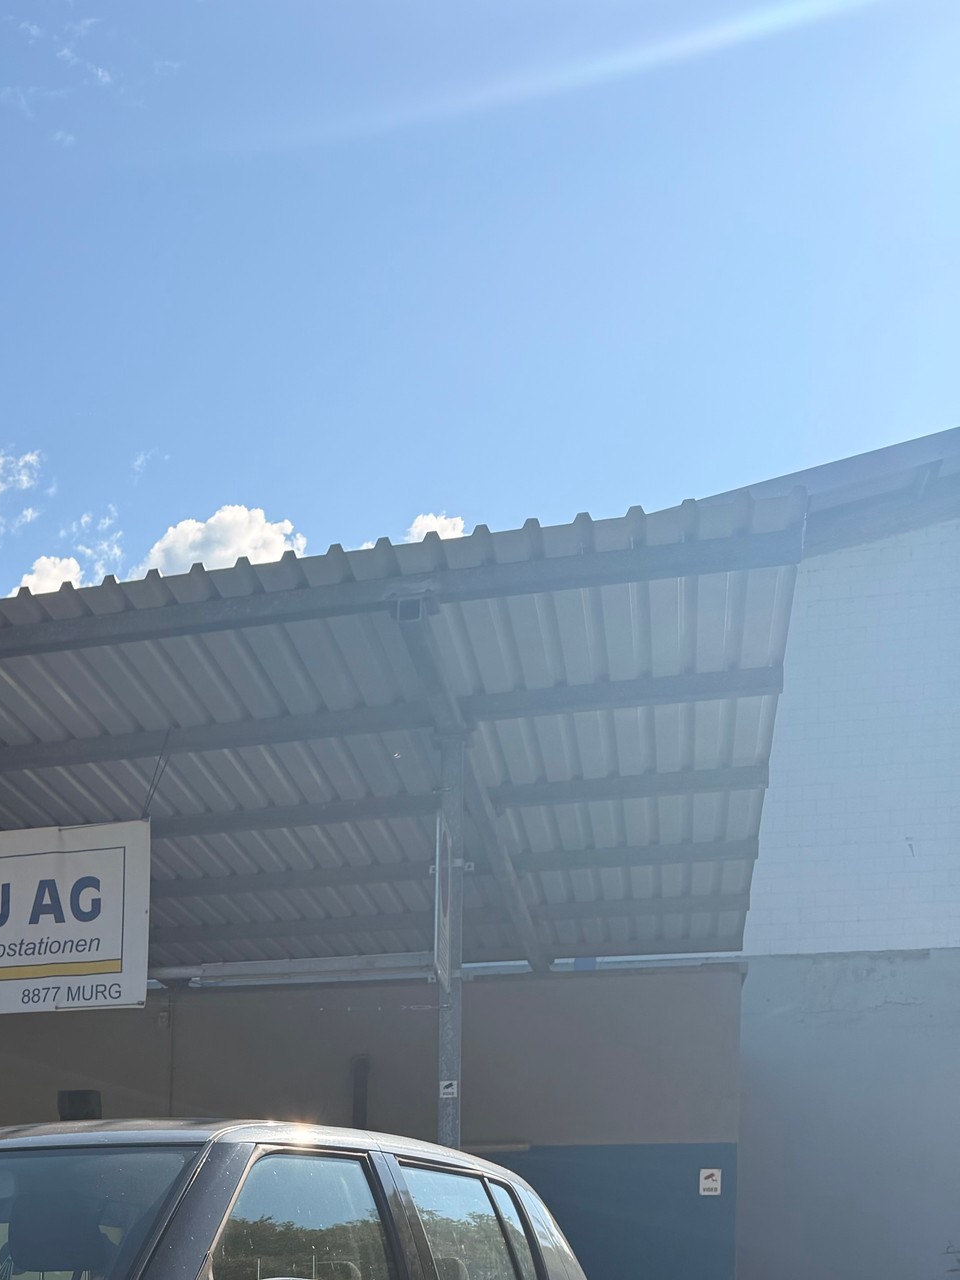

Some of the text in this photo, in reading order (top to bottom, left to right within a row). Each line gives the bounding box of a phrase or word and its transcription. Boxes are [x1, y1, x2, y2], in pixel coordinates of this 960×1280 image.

[28, 876, 102, 925] AG
[21, 983, 122, 1005] 8877 MURG
